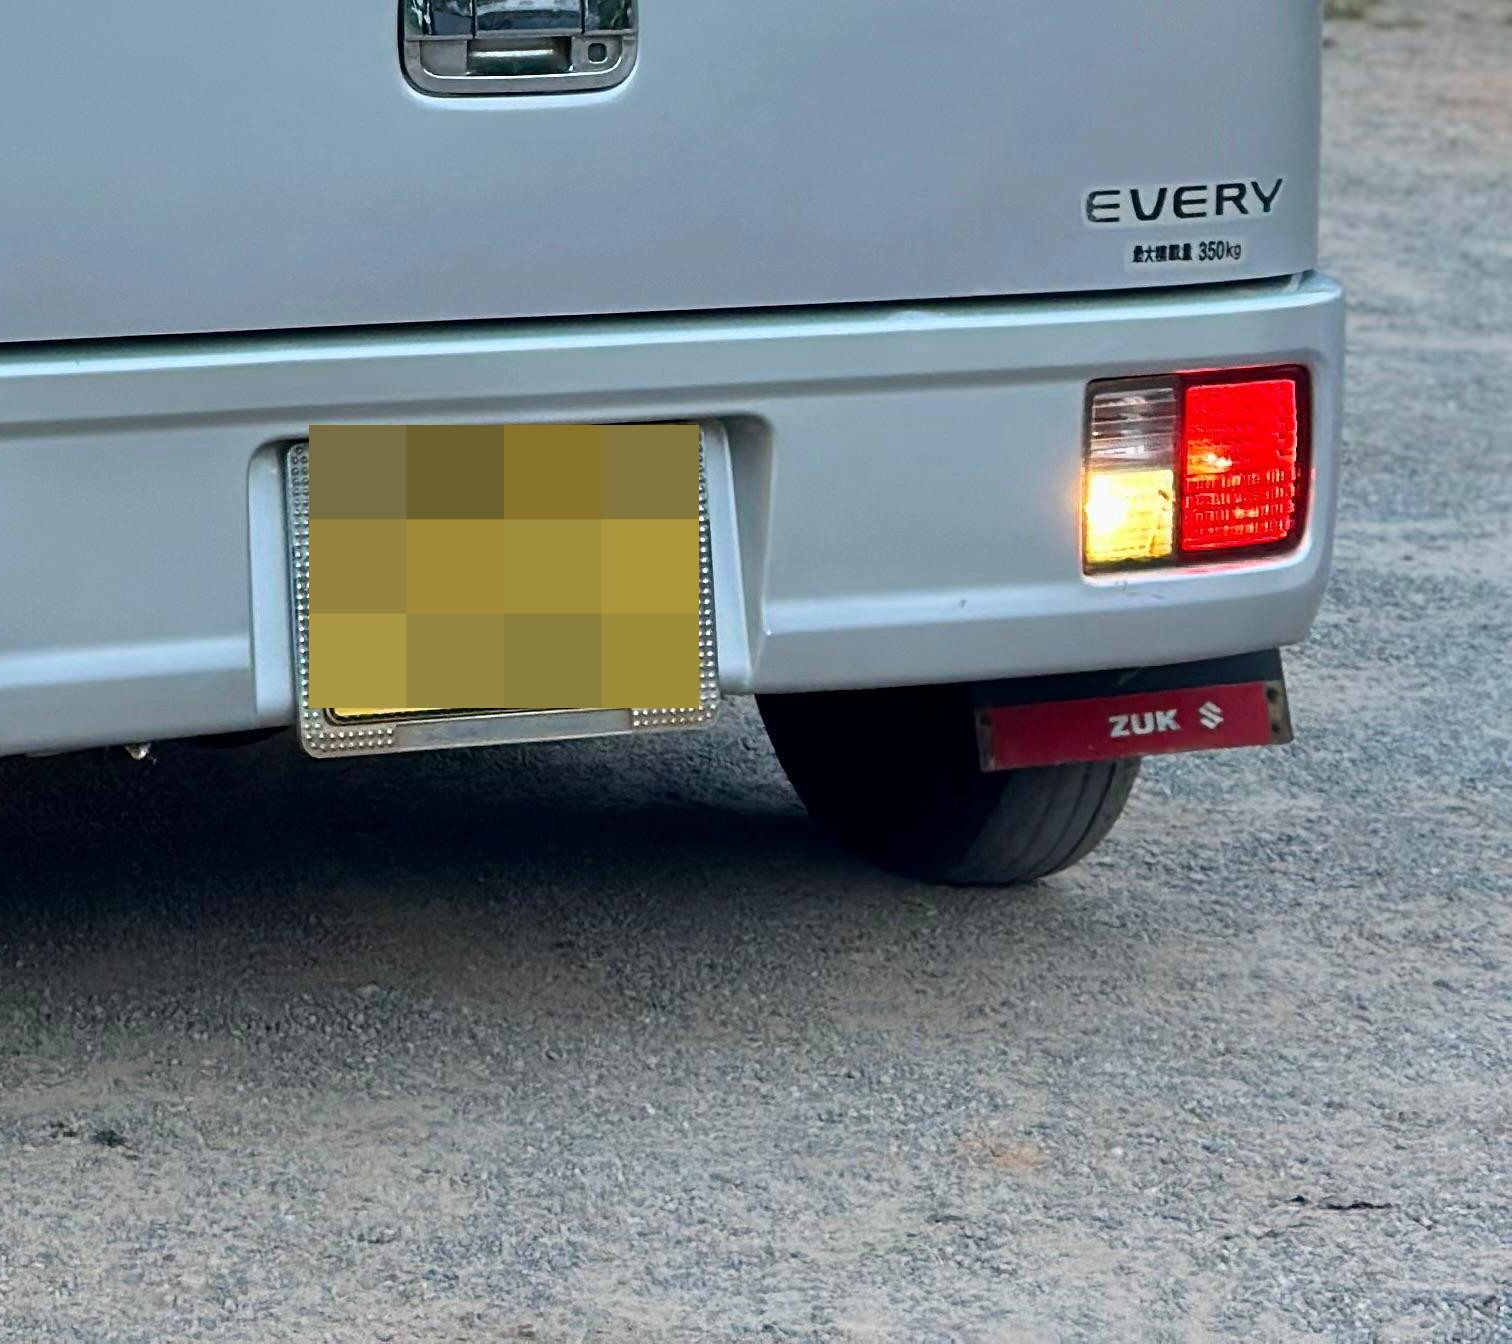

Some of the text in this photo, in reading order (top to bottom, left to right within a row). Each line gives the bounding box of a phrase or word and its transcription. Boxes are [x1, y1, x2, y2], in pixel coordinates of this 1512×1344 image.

[1085, 178, 1283, 223] EVERY
[1198, 240, 1242, 261] 350kg
[1108, 708, 1181, 738] ZUK
